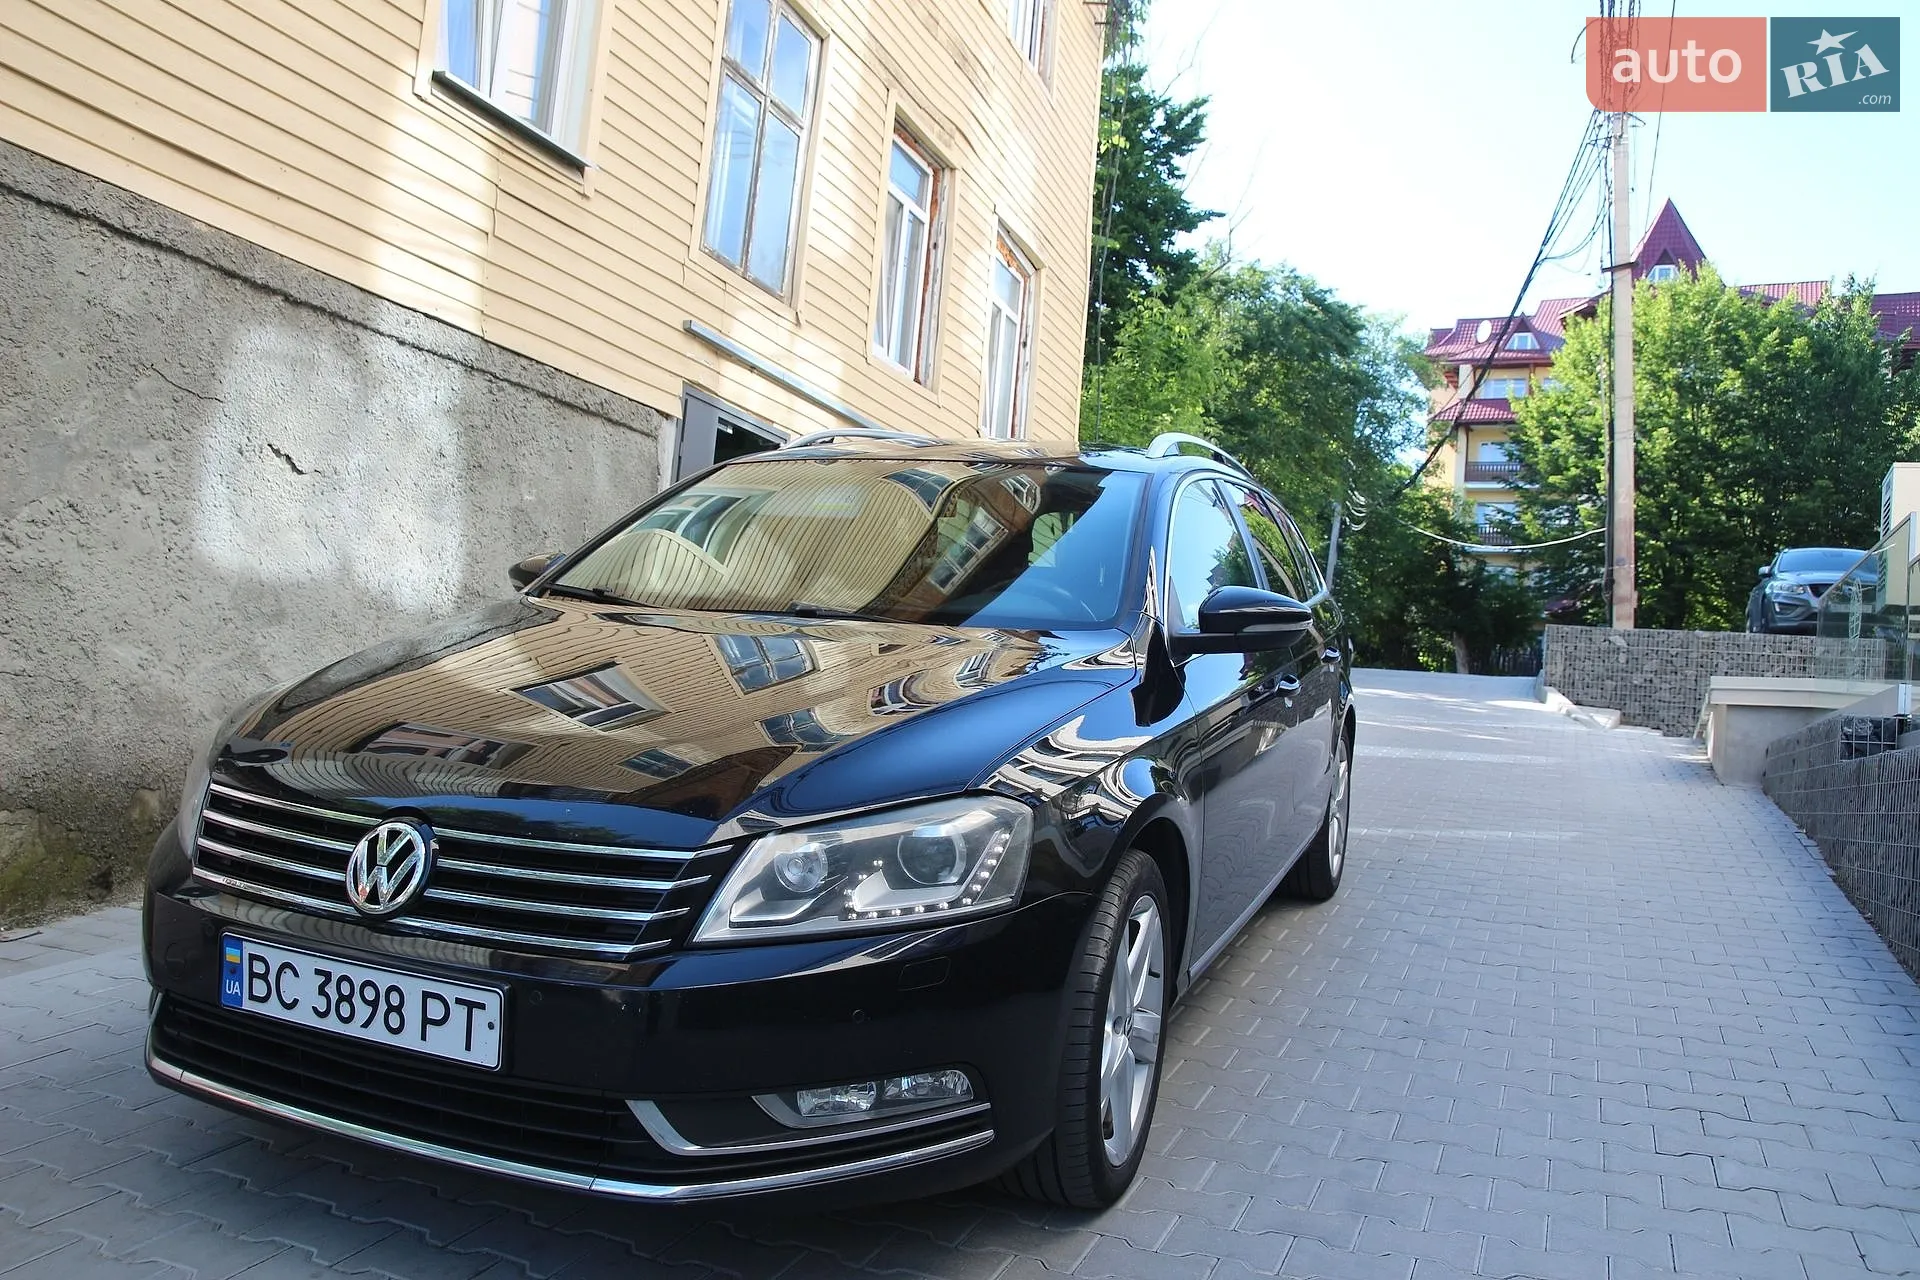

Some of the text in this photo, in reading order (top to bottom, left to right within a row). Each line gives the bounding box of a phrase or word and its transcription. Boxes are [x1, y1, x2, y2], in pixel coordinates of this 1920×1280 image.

[226, 980, 241, 996] UA
[248, 952, 487, 1052] BC 3898 PT
